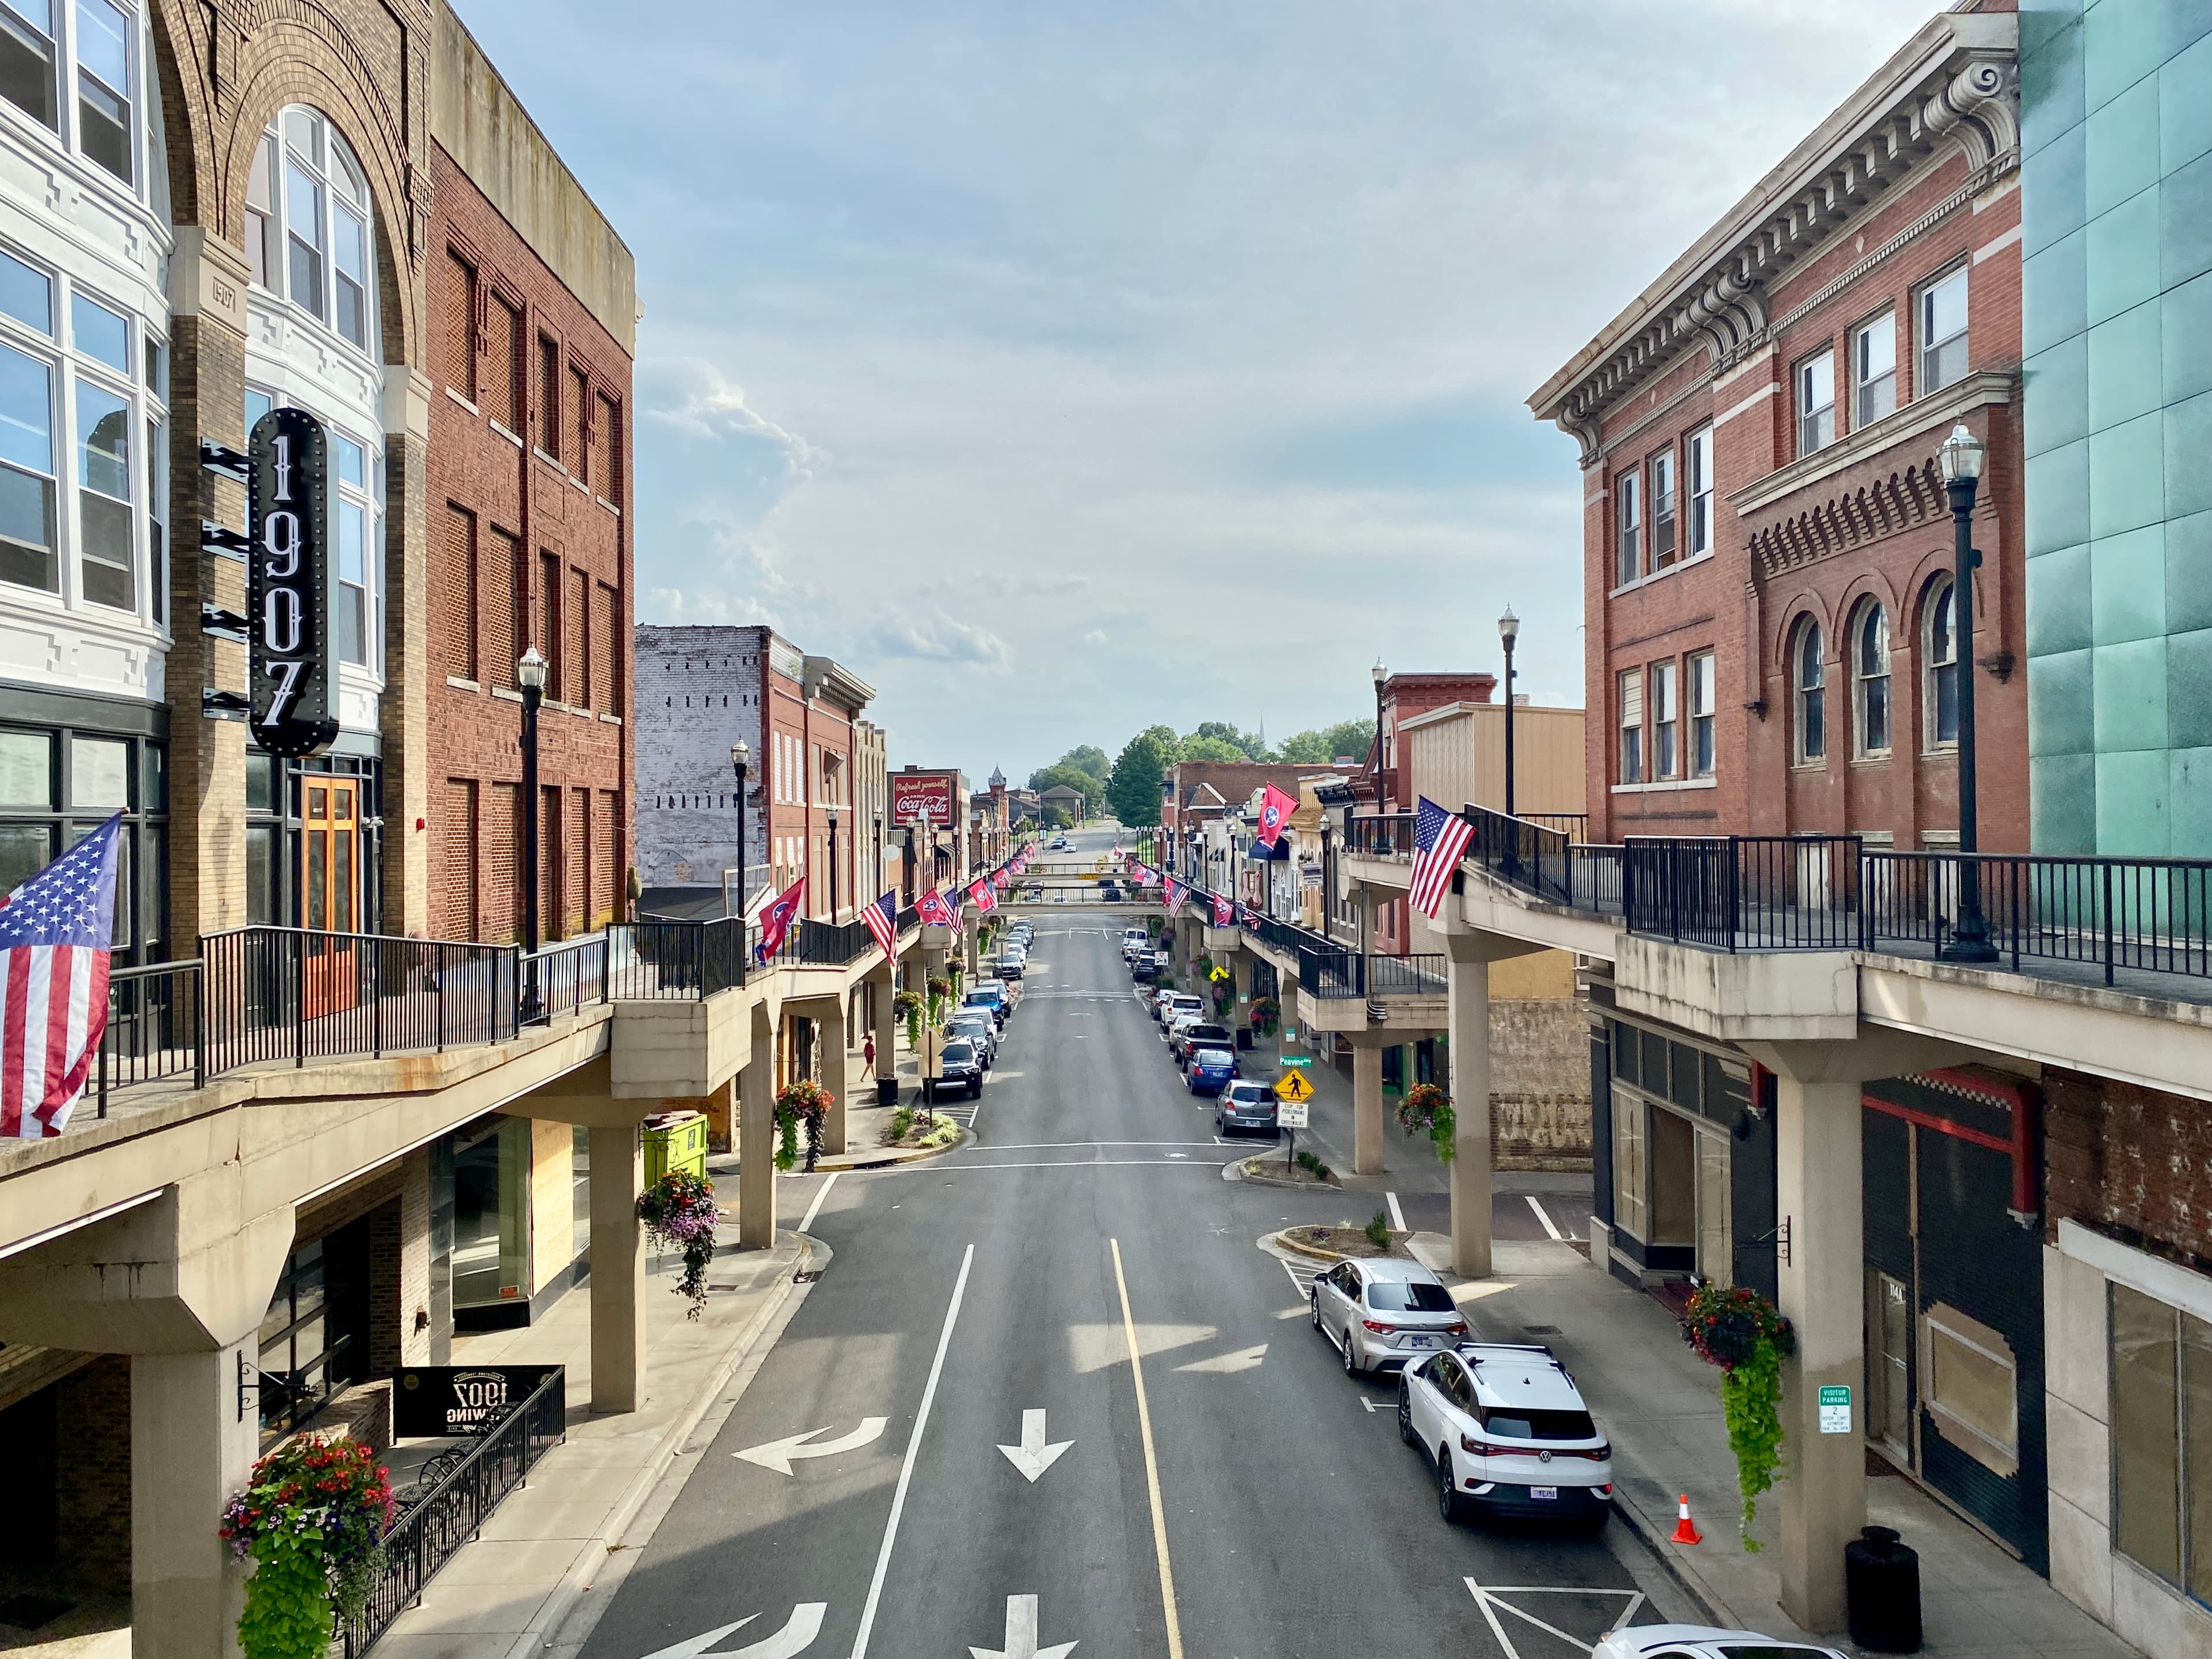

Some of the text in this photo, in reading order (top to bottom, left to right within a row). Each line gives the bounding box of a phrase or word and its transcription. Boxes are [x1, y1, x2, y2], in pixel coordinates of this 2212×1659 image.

[213, 280, 234, 309] 1907
[261, 435, 303, 727] 1907
[896, 780, 921, 793] Refresh
[1280, 1057, 1304, 1066] Peavine
[1832, 1406, 1838, 1415] 2
